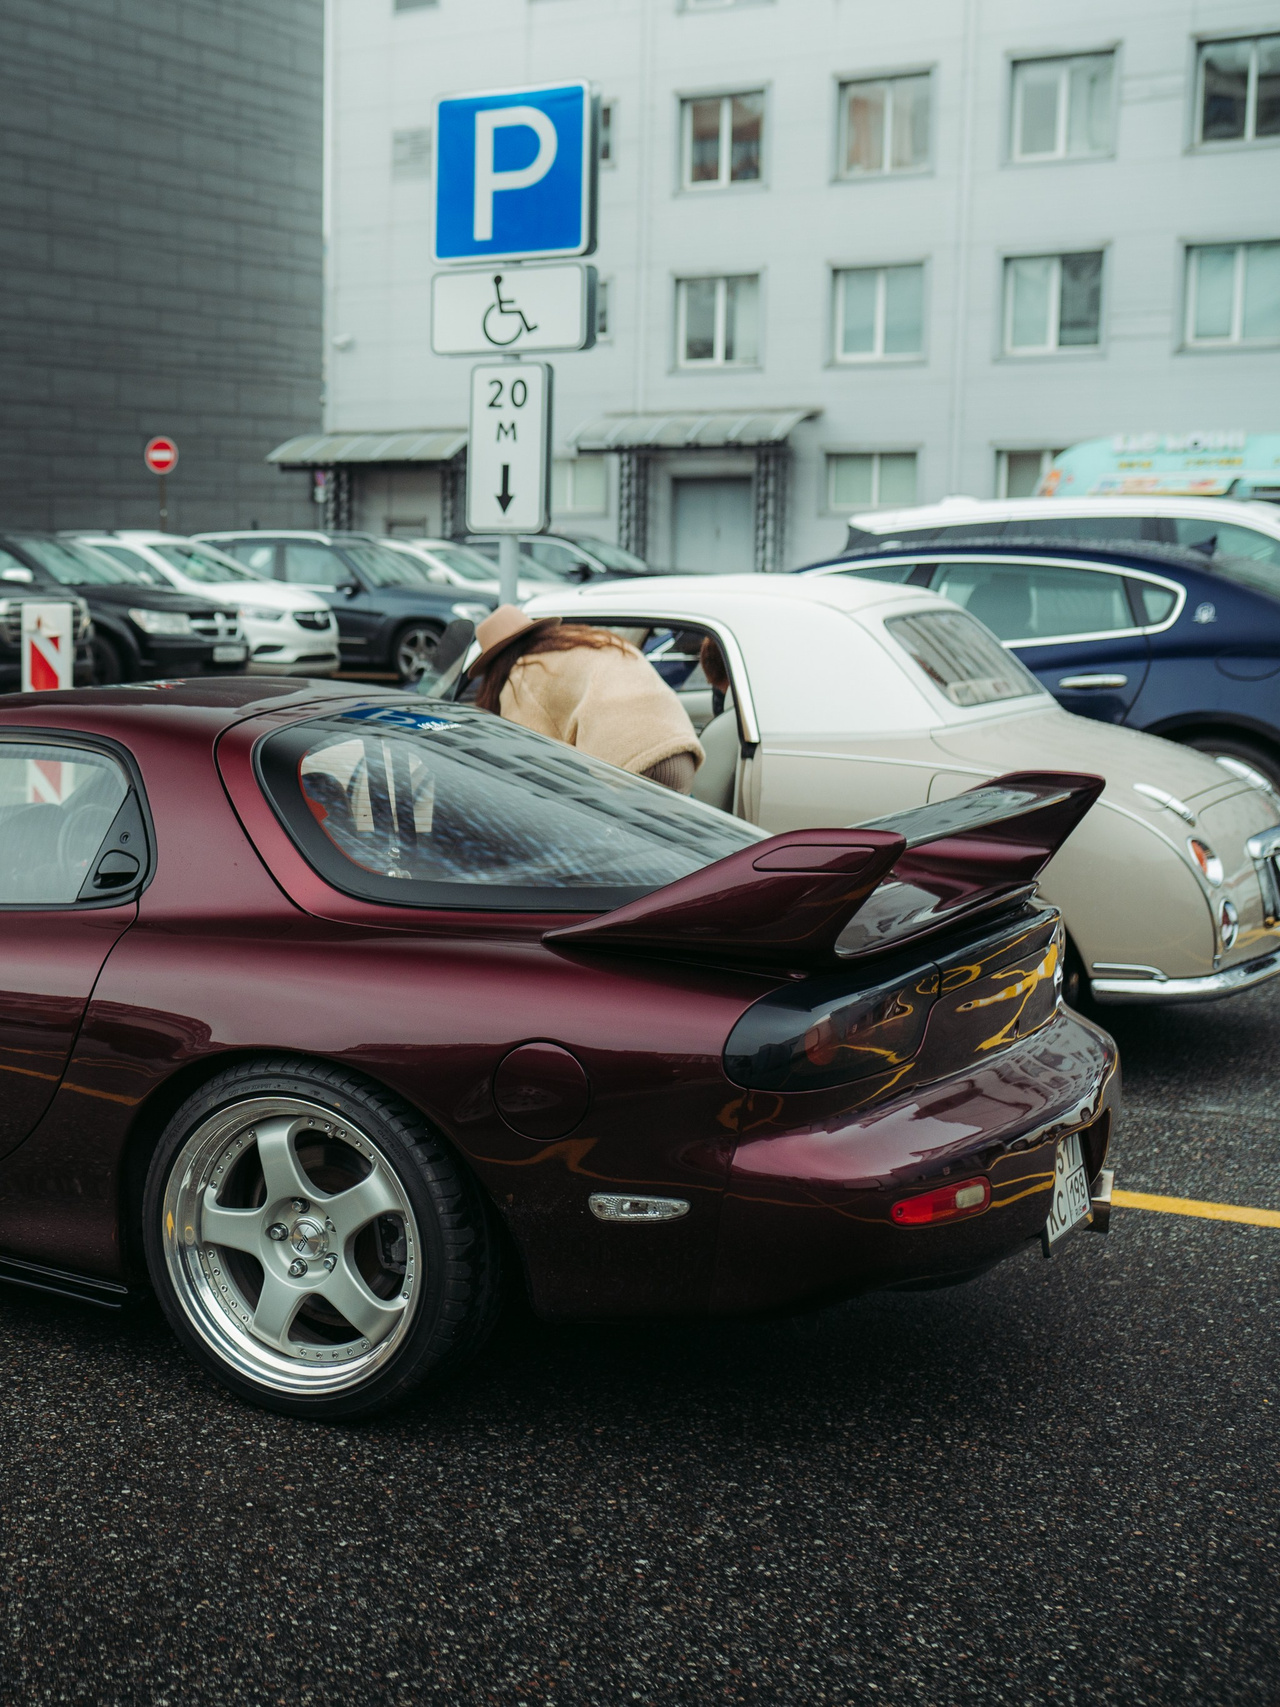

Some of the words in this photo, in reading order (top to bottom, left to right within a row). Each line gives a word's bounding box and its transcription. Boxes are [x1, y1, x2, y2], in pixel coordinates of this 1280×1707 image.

[473, 106, 558, 241] P
[488, 379, 527, 408] 20
[1070, 1172, 1086, 1207] 198
